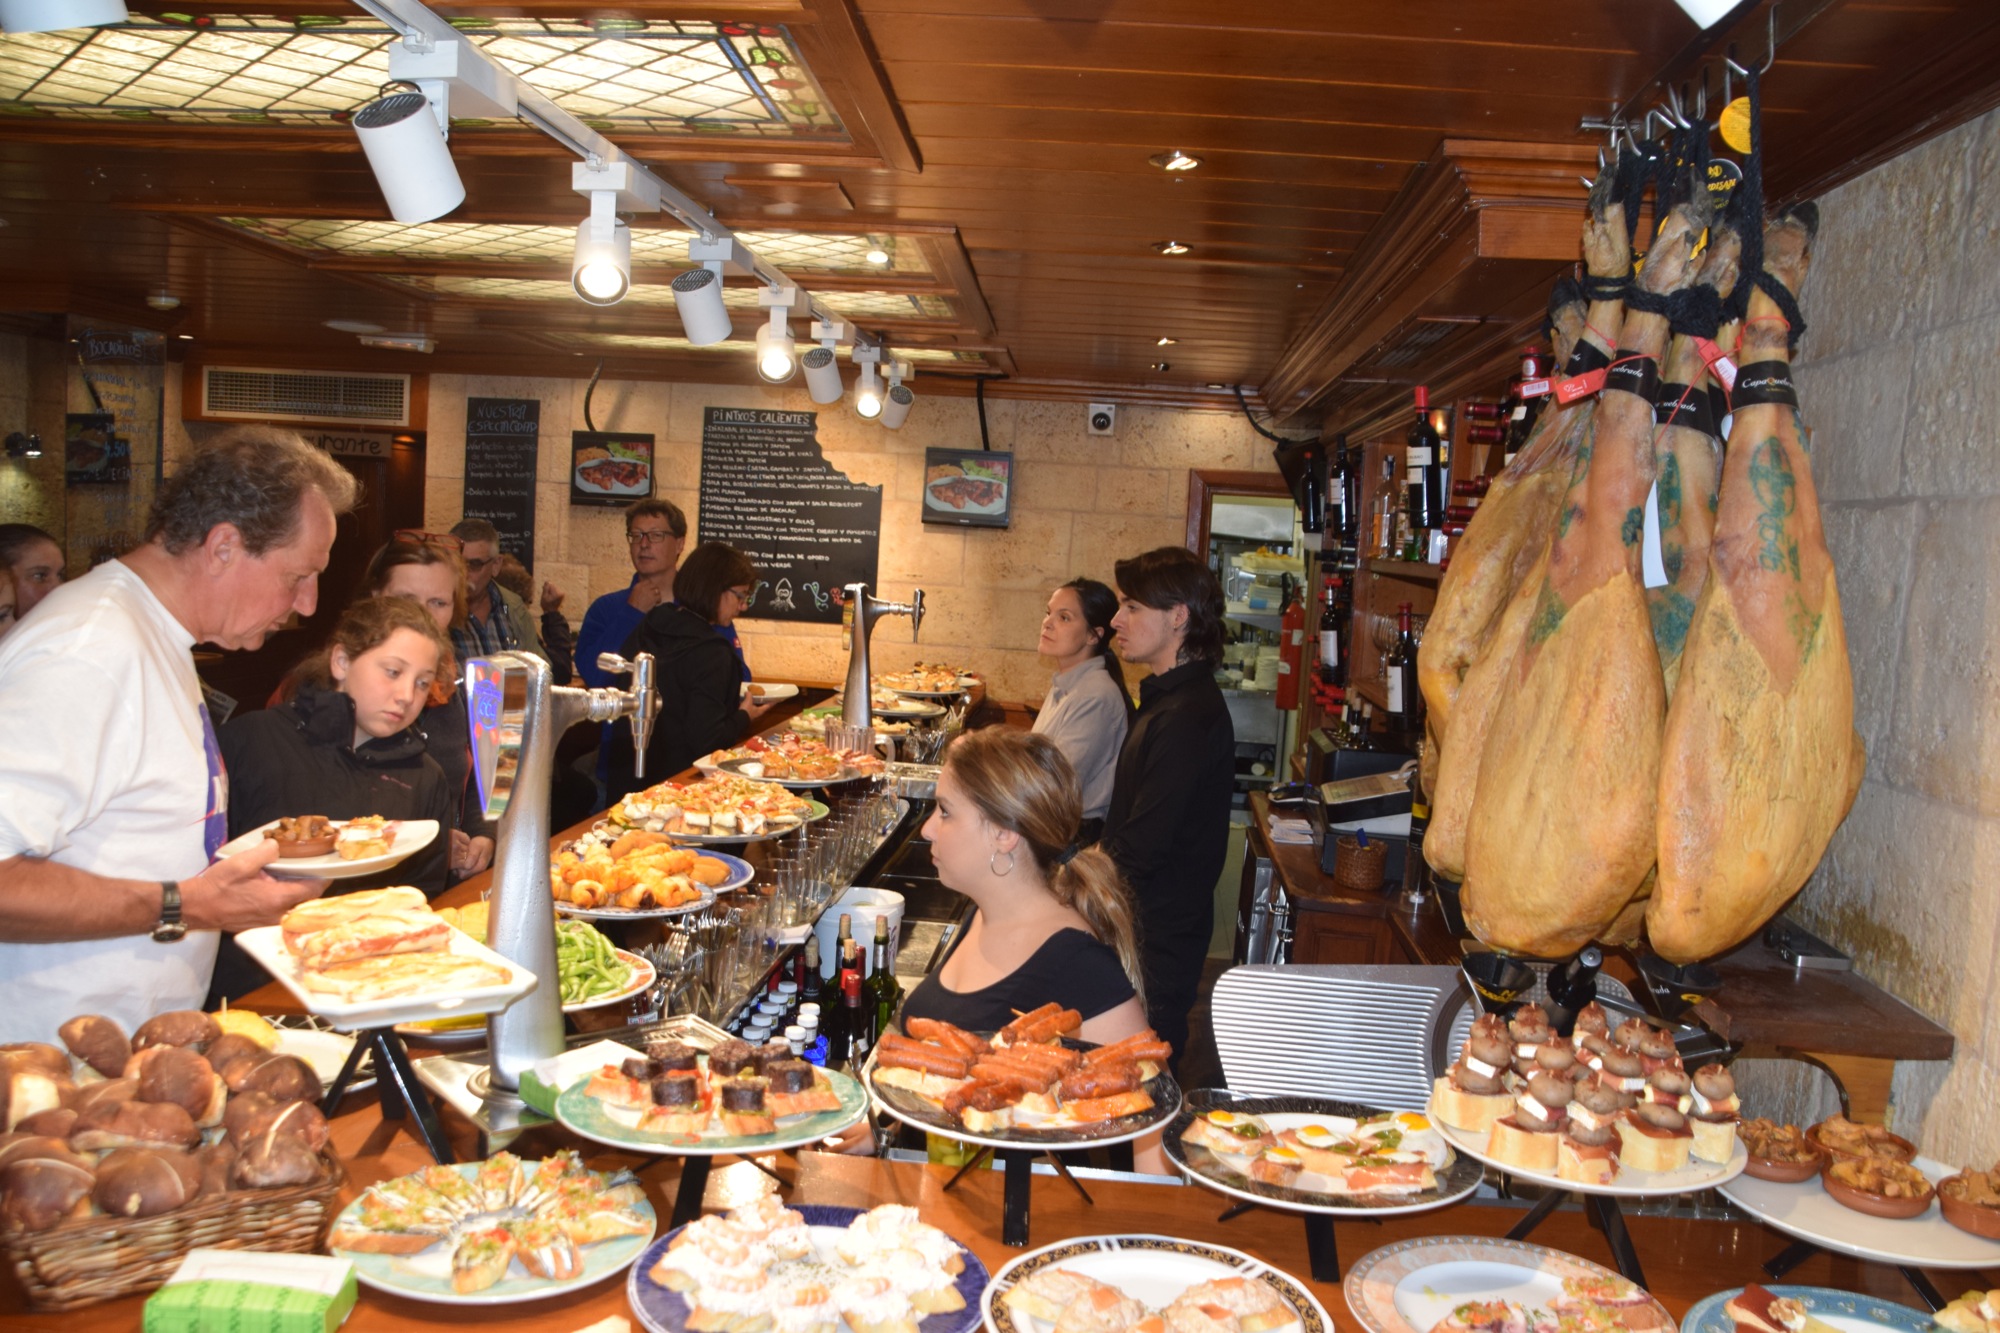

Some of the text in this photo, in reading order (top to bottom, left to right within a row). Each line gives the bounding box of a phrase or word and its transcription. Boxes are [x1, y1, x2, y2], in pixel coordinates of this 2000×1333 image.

[88, 339, 142, 358] BOCADILLOS
[1612, 364, 1643, 378] uebrada
[477, 402, 527, 420] NUESTRA
[713, 409, 810, 425] PINTXOS CALIENTES
[721, 488, 746, 496] PLANCHA
[705, 512, 736, 520] BROCHETA
[746, 515, 786, 524] LANGOSTINOS
[705, 521, 734, 530] BROCHETA
[744, 524, 774, 532] SOLOMILLO
[807, 554, 830, 562] OPORTO
